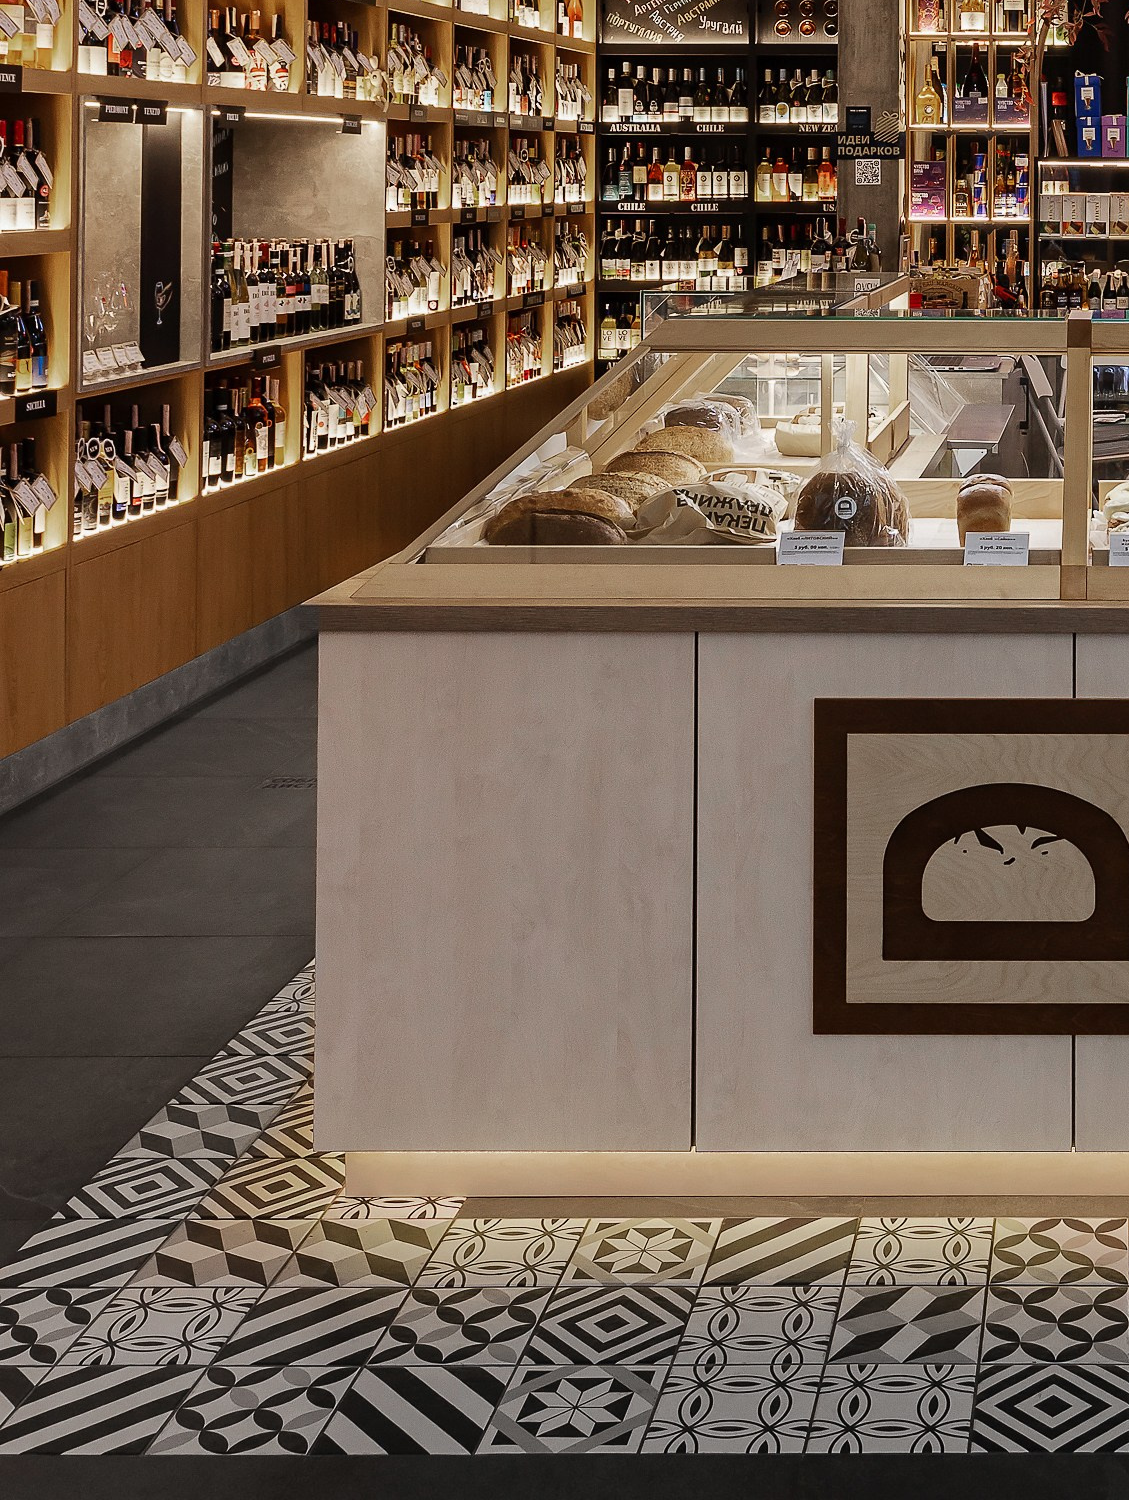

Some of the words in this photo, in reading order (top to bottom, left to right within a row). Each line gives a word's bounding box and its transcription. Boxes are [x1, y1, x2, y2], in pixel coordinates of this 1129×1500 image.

[648, 9, 685, 43] АВСТРИЯ
[609, 124, 661, 133] AUSTRALIA
[696, 124, 724, 133] CHILE
[798, 124, 819, 133] NEW
[837, 135, 870, 145] ИДЕИ
[837, 146, 900, 157] ПОДАРКОВ
[617, 203, 646, 211] CHILE
[691, 203, 719, 211] CHILE
[26, 399, 46, 412] SICILIA
